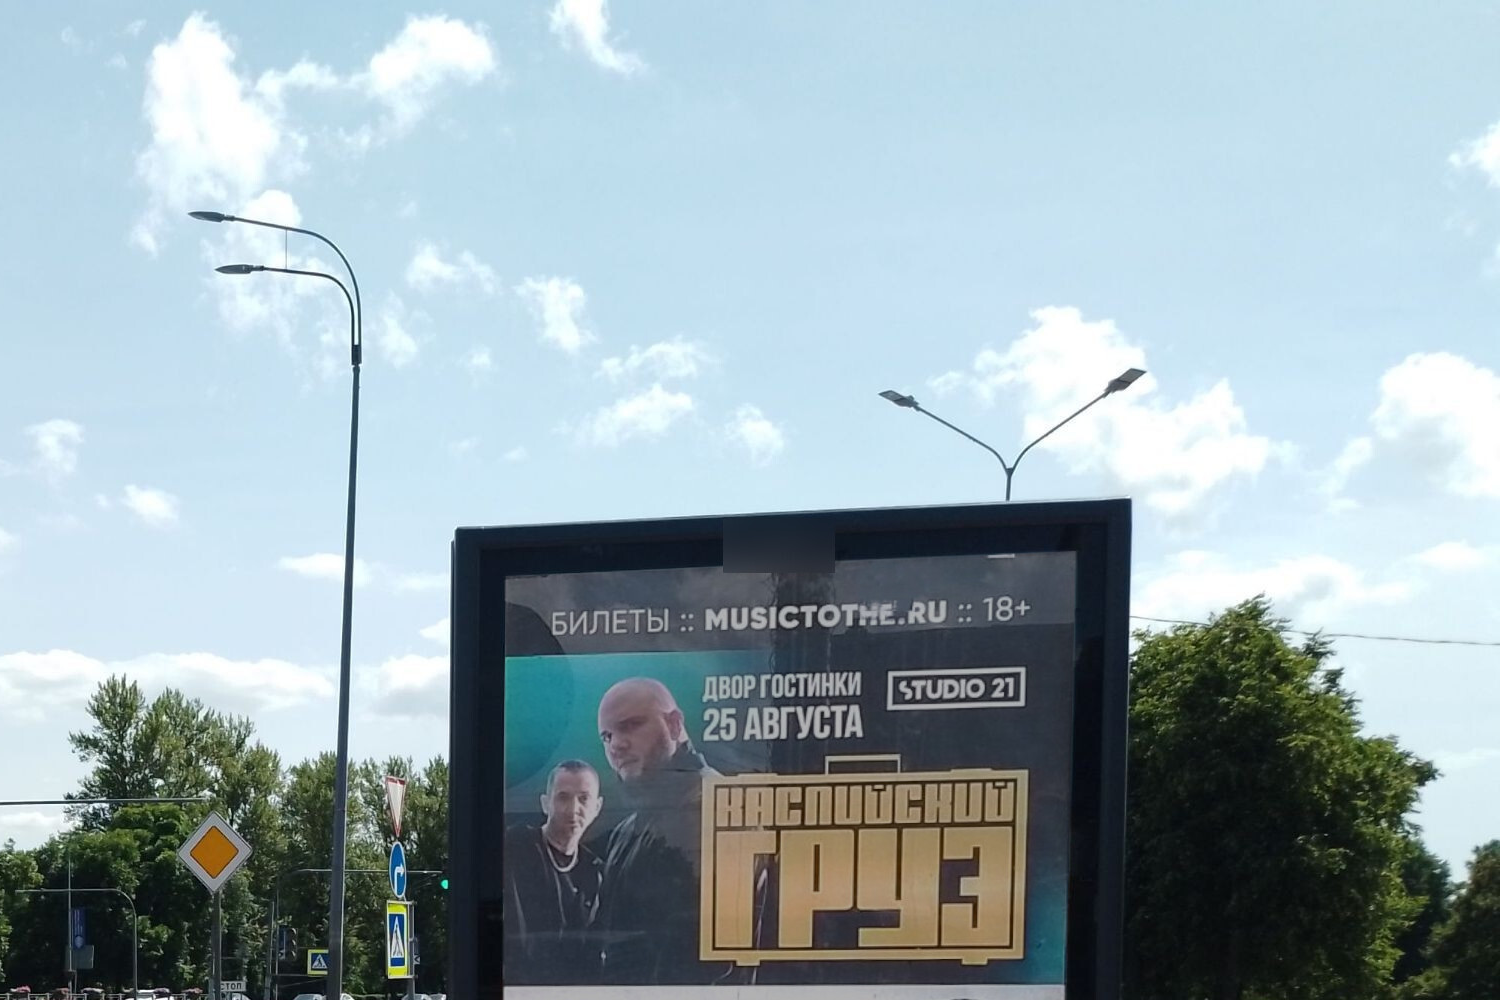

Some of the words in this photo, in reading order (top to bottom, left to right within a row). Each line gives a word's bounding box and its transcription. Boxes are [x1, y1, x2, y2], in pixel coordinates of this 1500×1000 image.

[552, 608, 669, 635] БИЛЕТЫ
[705, 600, 947, 631] MUSICTOTHE.RU
[983, 596, 1031, 622] 18+
[702, 675, 758, 702] ДВОР
[760, 672, 862, 699] ГОСТИНКИ
[899, 678, 985, 700] STUDIO
[991, 677, 1015, 699] 21
[703, 708, 736, 742] 25
[744, 705, 864, 740] АВГУСТА
[715, 781, 1015, 827] КАСПИЙСКИЙ
[714, 826, 1014, 948] ГРУЗ
